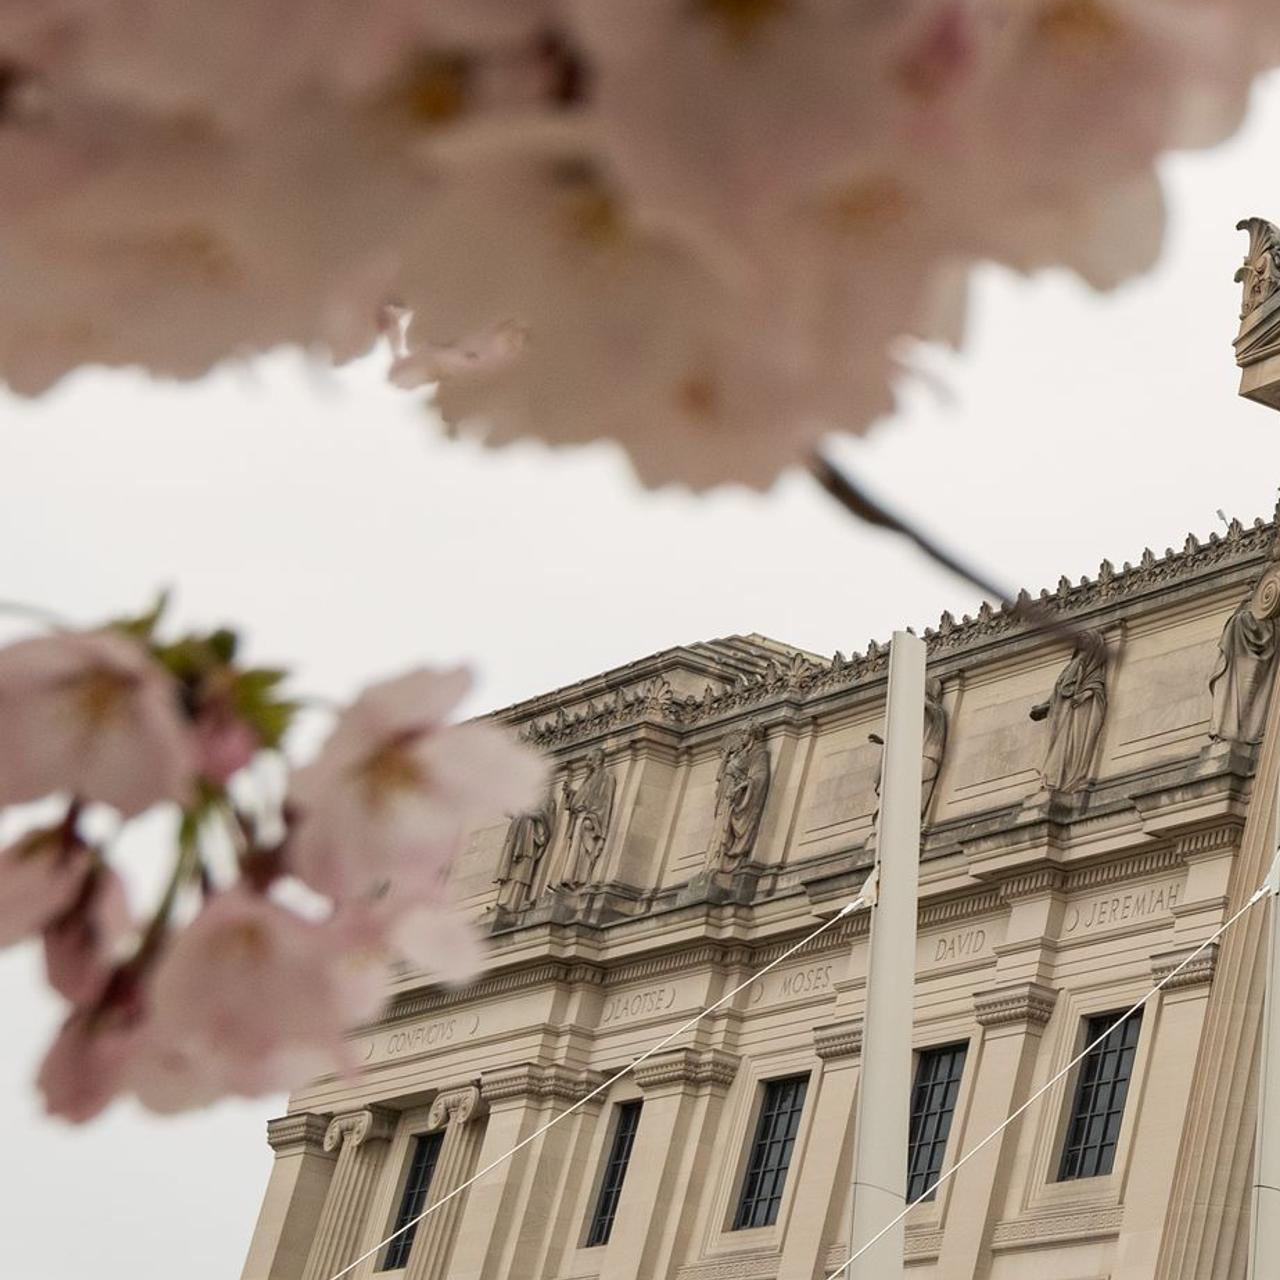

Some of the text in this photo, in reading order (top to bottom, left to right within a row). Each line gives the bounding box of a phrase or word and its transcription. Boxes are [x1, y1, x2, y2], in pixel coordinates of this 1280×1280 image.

[1084, 882, 1180, 928] JEREMIAH
[934, 929, 986, 962] DAVID
[779, 965, 833, 996] MOSES
[613, 988, 665, 1020] LAOTSE
[387, 1019, 456, 1055] CONFVCIVS
